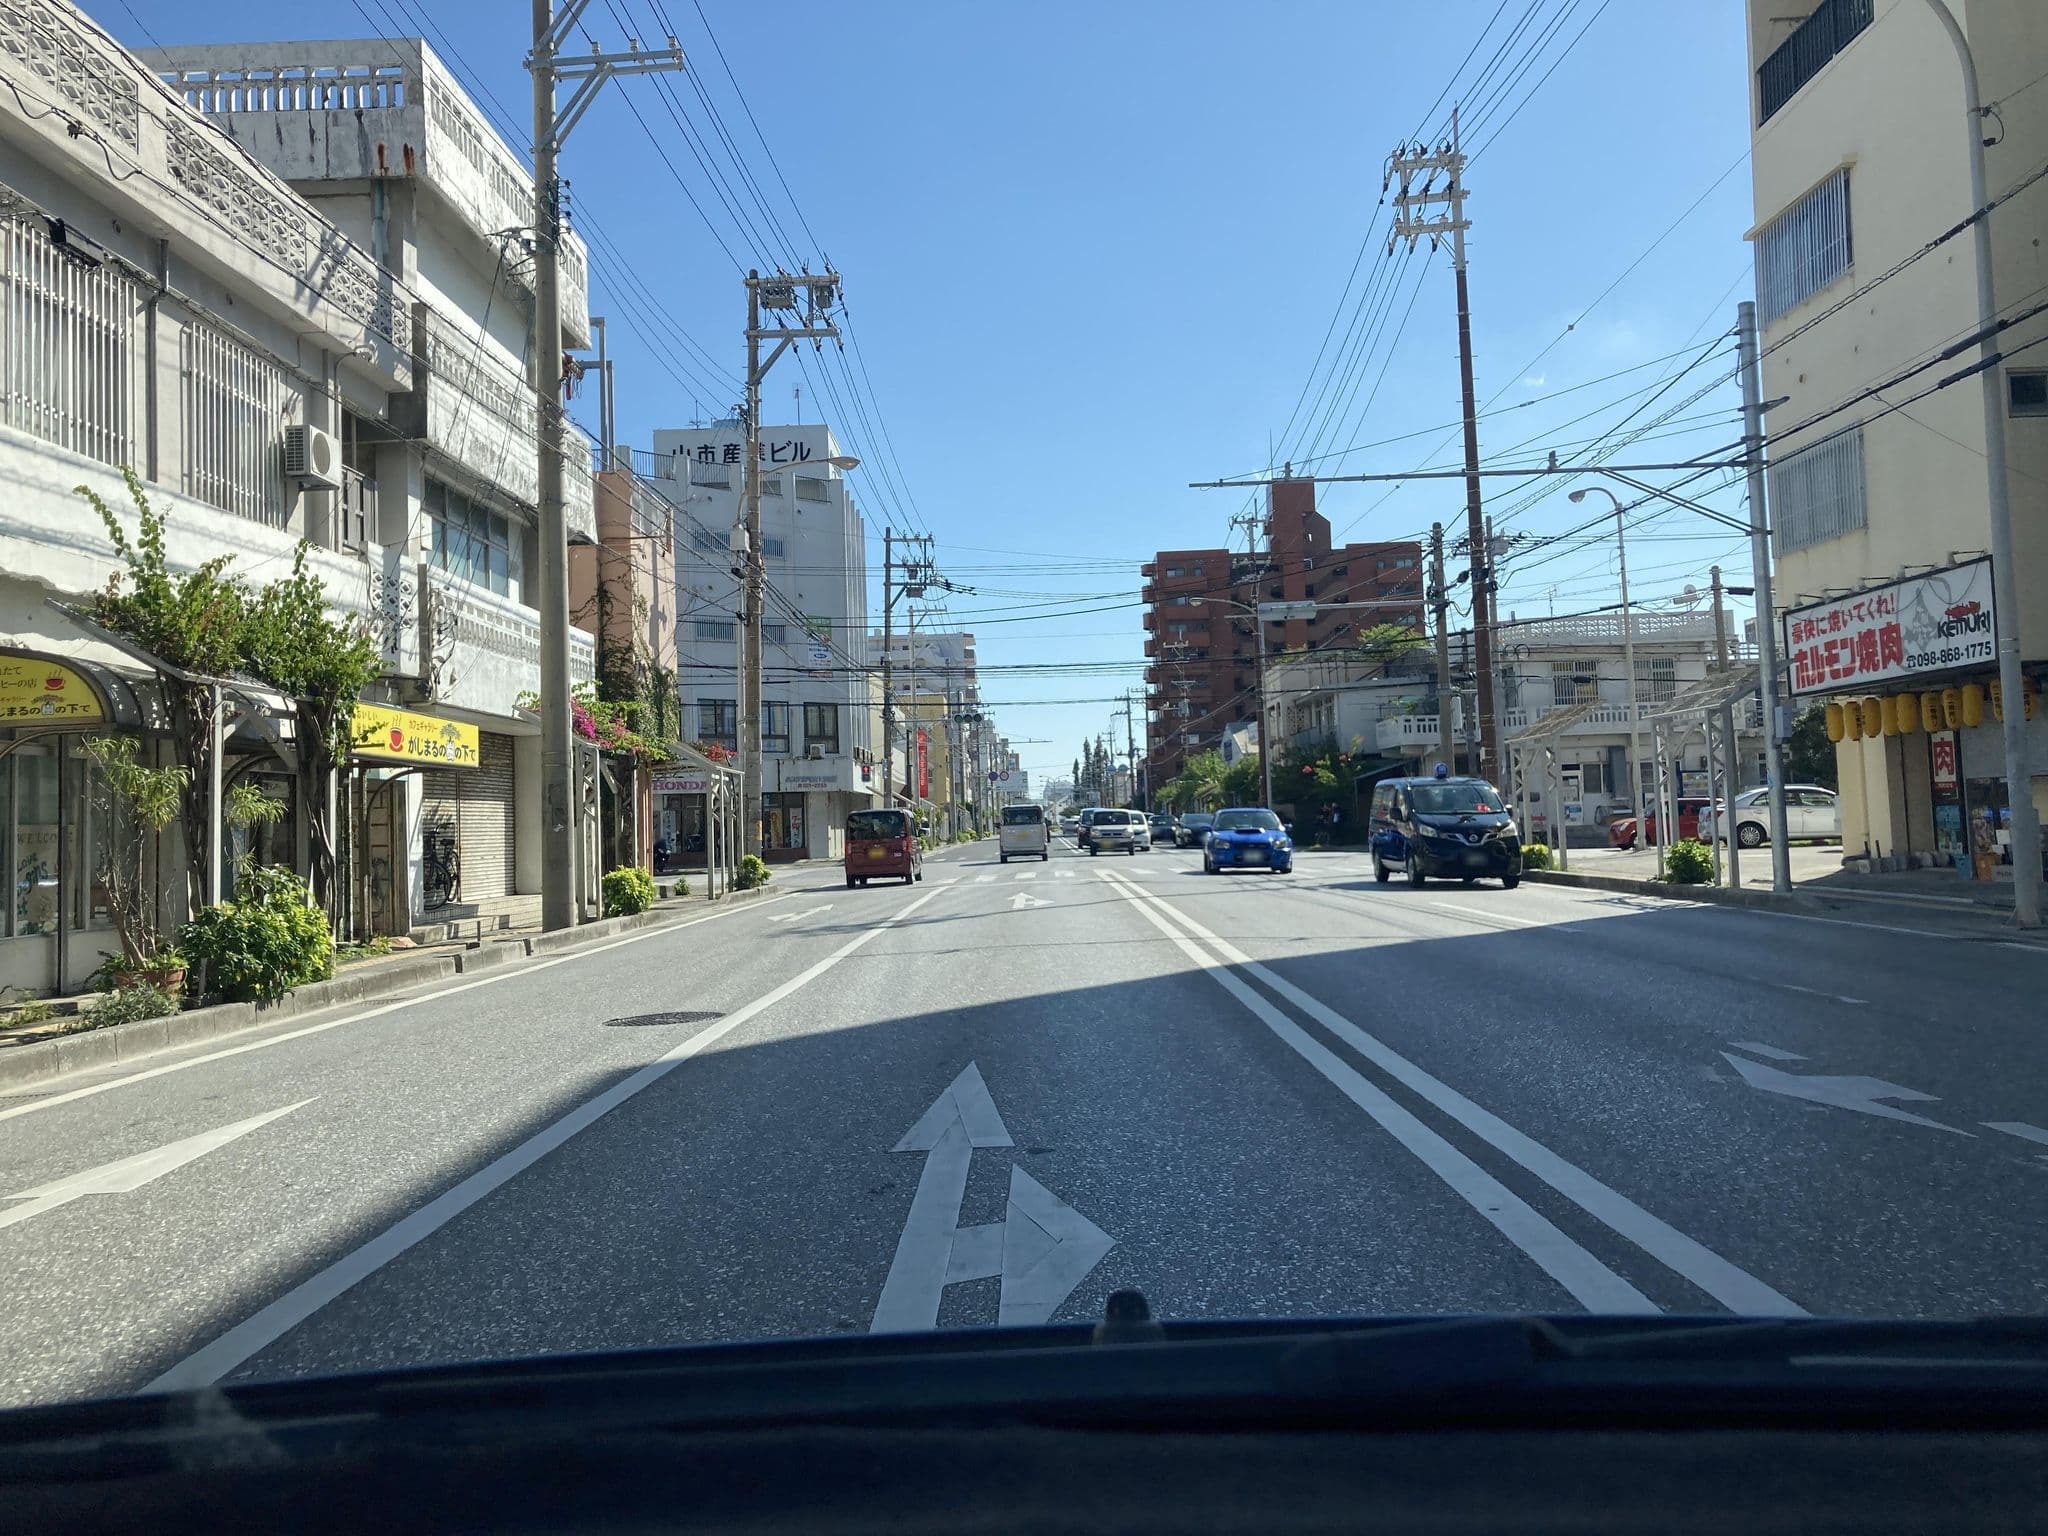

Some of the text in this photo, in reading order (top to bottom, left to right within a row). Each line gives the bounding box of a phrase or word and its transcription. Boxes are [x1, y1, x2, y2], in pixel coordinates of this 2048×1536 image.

[1794, 621, 1904, 689] ホルモン焼肉
[1932, 736, 1955, 777] 肉
